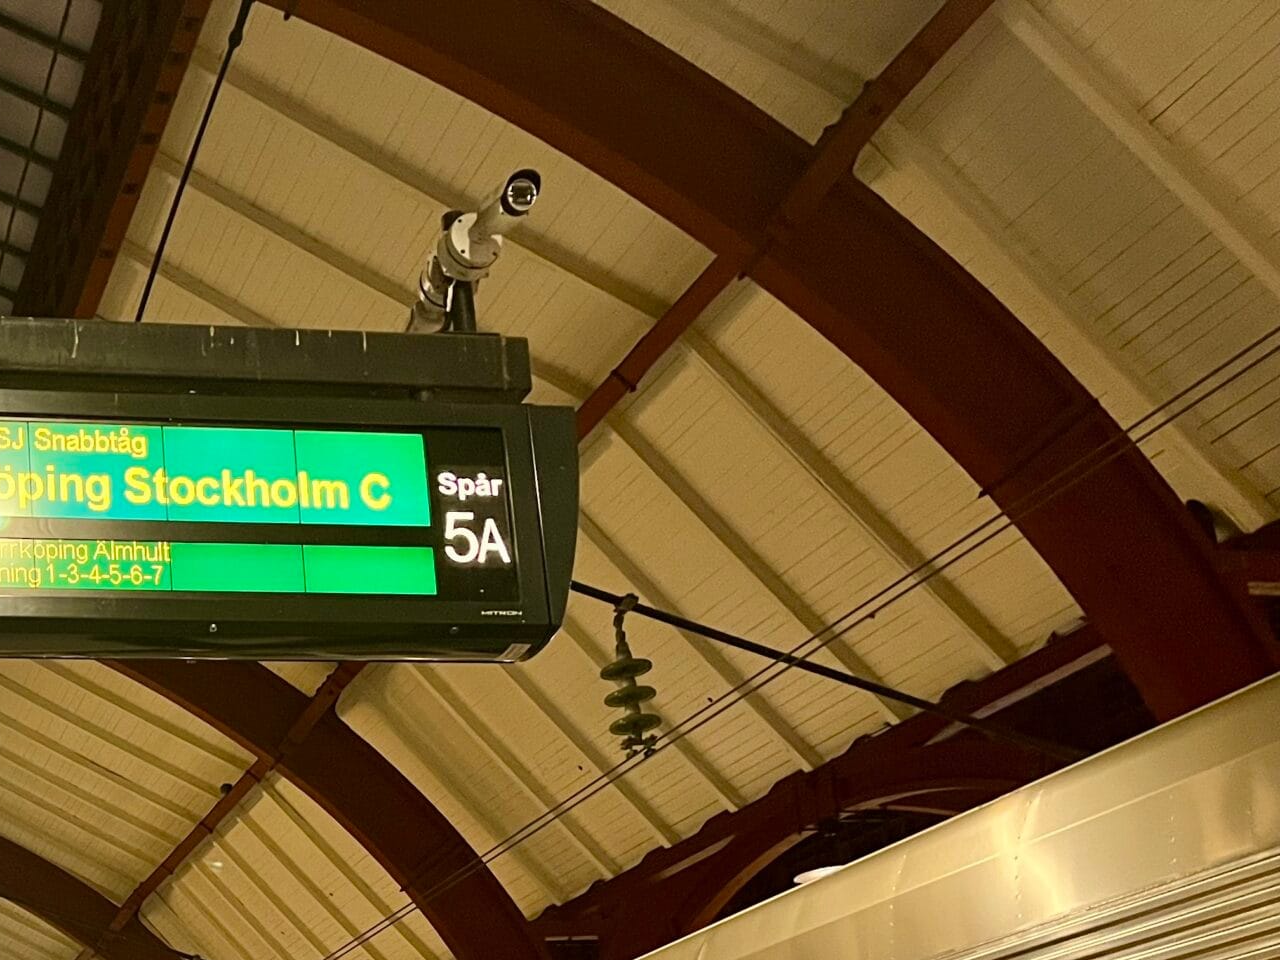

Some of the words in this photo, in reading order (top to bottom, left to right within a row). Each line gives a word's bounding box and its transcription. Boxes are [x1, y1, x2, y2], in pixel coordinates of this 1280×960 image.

[34, 427, 148, 459] Snabbtåg
[123, 466, 350, 509] Stockholm
[359, 472, 392, 511] C
[437, 471, 503, 501] Spår
[93, 540, 171, 562] Älmhult
[443, 510, 511, 564] 5A
[47, 563, 163, 585] 1-3-4-5-6-7
